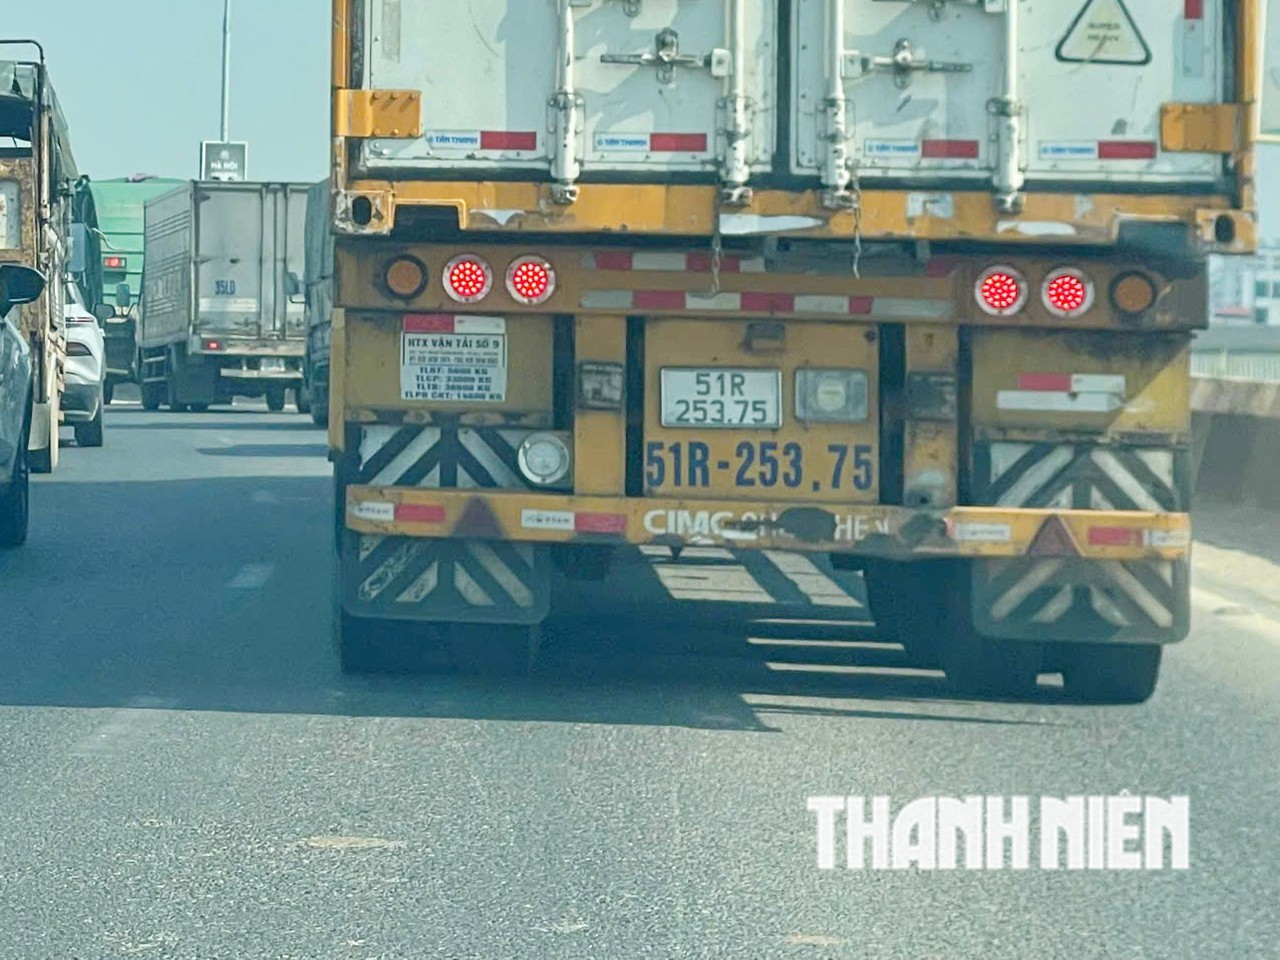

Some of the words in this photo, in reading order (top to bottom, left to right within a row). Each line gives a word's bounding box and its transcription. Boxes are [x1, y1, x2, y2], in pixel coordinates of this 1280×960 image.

[407, 338, 429, 348] HTX
[492, 340, 500, 349] 9
[695, 373, 746, 396] 51R
[675, 399, 768, 424] 253.75
[643, 508, 734, 536] CIMC
